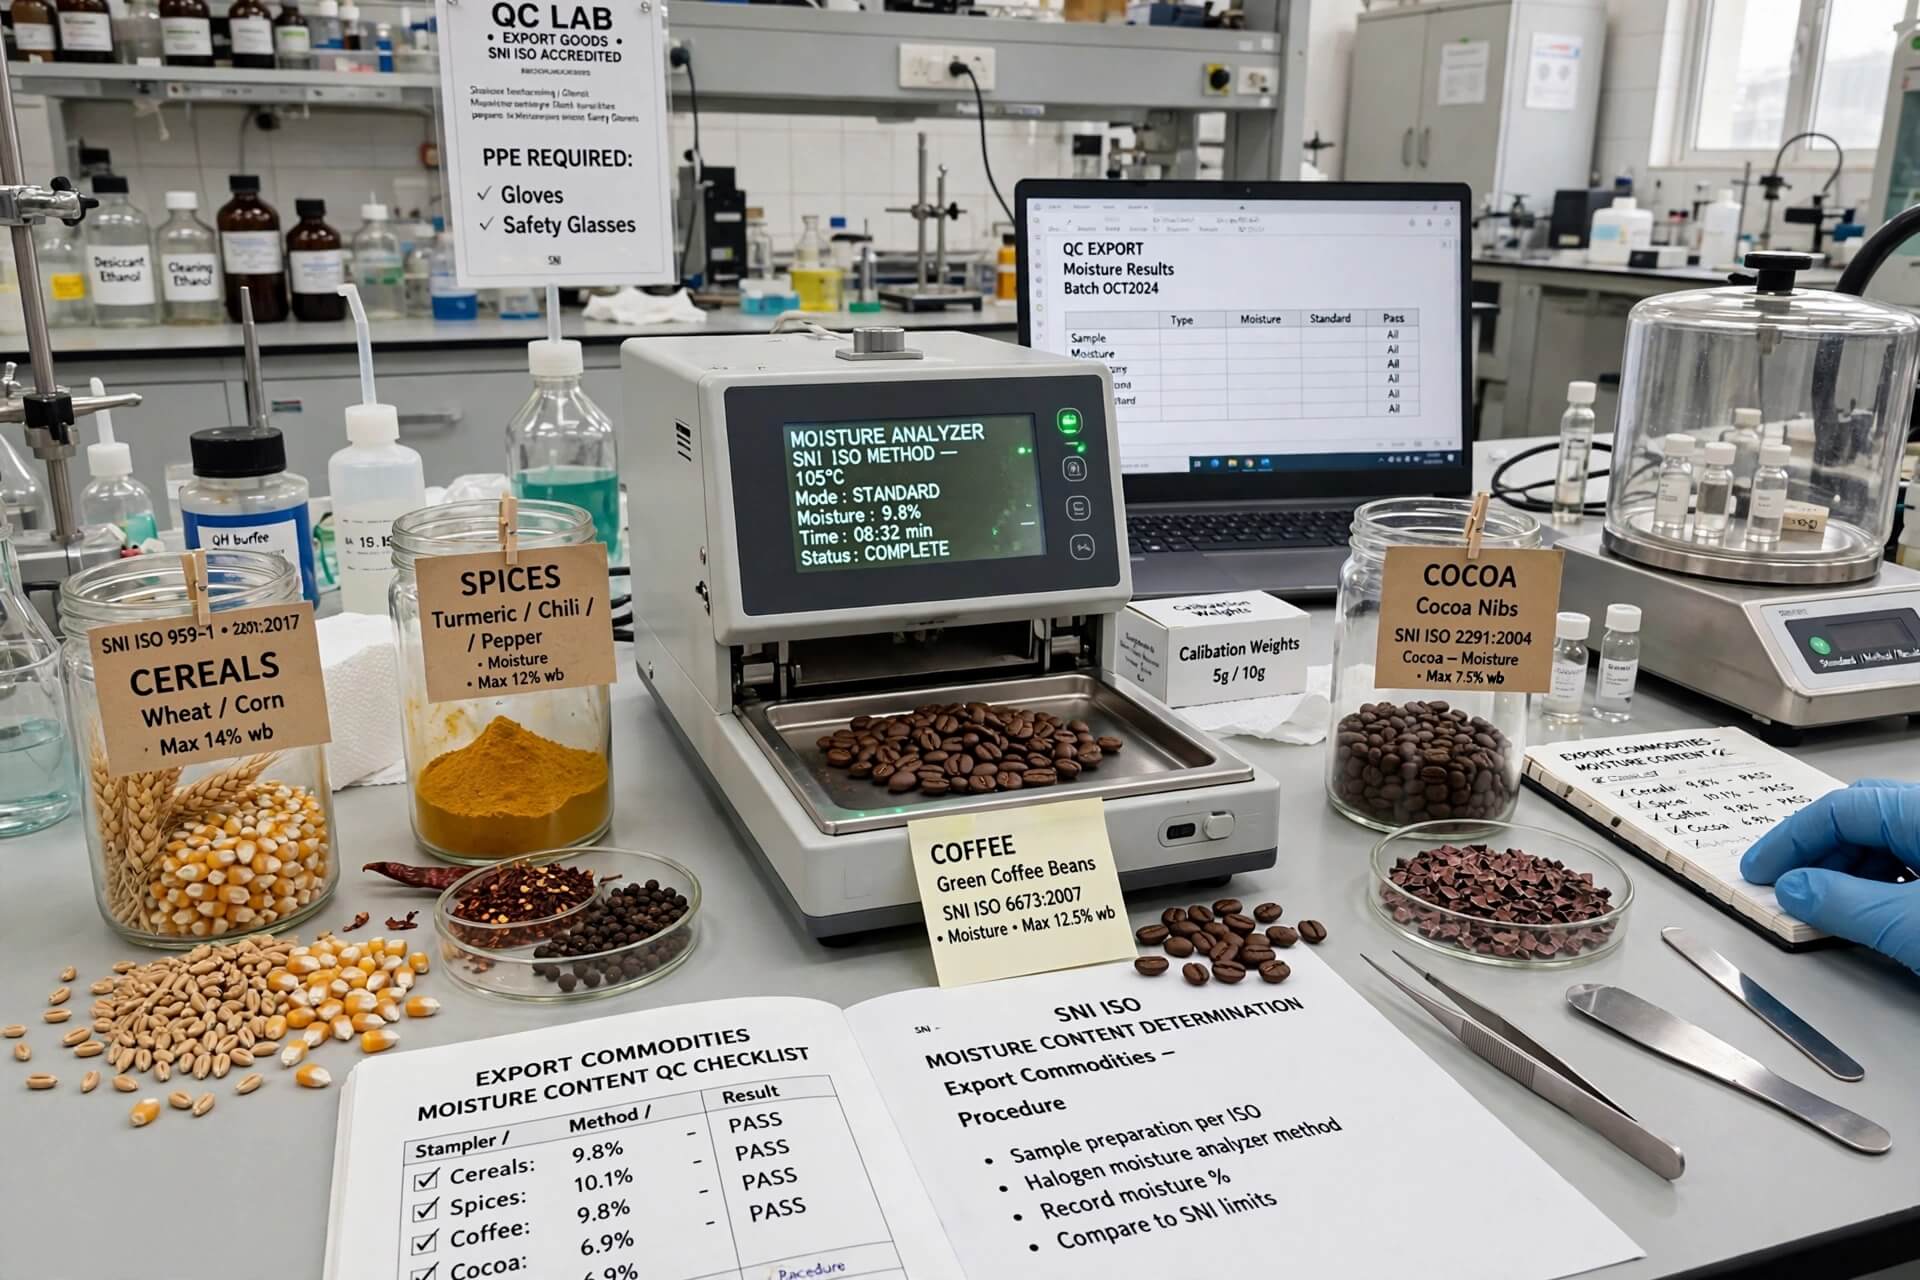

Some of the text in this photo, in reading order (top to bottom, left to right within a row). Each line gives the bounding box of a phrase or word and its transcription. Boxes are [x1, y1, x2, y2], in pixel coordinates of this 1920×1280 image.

[491, 2, 613, 31] QC LAB
[503, 32, 609, 47] EXPORT GOODS
[488, 47, 622, 63] SNI ISO ACCREDITED
[483, 148, 633, 169] PPE REQUIRED:
[501, 184, 564, 204] Gloves
[503, 215, 637, 238] Safety Glasses
[1063, 241, 1144, 257] QC EXPORT
[1063, 261, 1175, 277] Moisture Results
[1064, 281, 1160, 296] Batch OCT2024
[1171, 315, 1194, 327] Type
[1240, 313, 1282, 326] Moisture
[1310, 313, 1352, 325] Standard
[1071, 333, 1106, 345] Sample
[790, 422, 985, 448] MOISTURE ANALYZER
[792, 445, 935, 468] SNI ISO METHOD
[796, 468, 845, 487] 105°C
[852, 483, 940, 503] STANDARD
[881, 505, 922, 521] 9.8%
[853, 524, 900, 543] 08:32
[905, 523, 933, 538] min
[864, 540, 951, 562] COMPLETE
[460, 564, 561, 596] SPICES
[1423, 563, 1517, 589] COCOA
[432, 605, 518, 629] Turmeric
[538, 598, 580, 619] Chili
[1416, 596, 1519, 617] Cocoa Nibs
[101, 635, 130, 655] SNI
[135, 631, 163, 651] ISO
[167, 624, 214, 647] 959-1
[481, 632, 543, 651] Pepper
[1179, 637, 1300, 662] Calibation Weights
[1394, 628, 1532, 646] SNI ISO 2291:2004
[488, 653, 549, 670] Moisture
[1402, 650, 1519, 666] Cocoa Moisture
[130, 651, 280, 697] CEREALS
[478, 667, 565, 689] Max 12% wb
[1213, 665, 1266, 685] 5g 10g
[1426, 670, 1505, 685] Max 7.5% wb
[141, 701, 213, 729] Wheat
[235, 693, 285, 714] Corn
[160, 722, 275, 756] Max 14% wb
[930, 834, 1016, 865] COFFEE
[937, 857, 1096, 893] Green Coffee Beans
[943, 886, 1082, 921] SNI ISO 6673:2007
[948, 905, 1116, 945] Moisture Max 12.5% wb
[1054, 997, 1142, 1023] SNI ISO
[924, 996, 1305, 1069] MOISTURE CONTENT DETERMINATION
[475, 1028, 751, 1087] EXPORT COMMODITIES
[417, 1046, 810, 1122] MOISTURE CONTENT QC CHECKLIST
[944, 1048, 1157, 1097] Export Commodities
[722, 1085, 780, 1105] Result
[568, 1107, 639, 1134] Method
[957, 1097, 1068, 1128] Procedure
[415, 1134, 497, 1159] Stampler
[1010, 1103, 1263, 1165] Sample preparation per ISO
[450, 1112, 783, 1186] Cereals: 9.8% PASS
[1025, 1117, 1343, 1191] Halogen moisture analyzer method
[449, 1139, 790, 1218] Spices: 10.1% PASS
[1040, 1168, 1231, 1220] Record moisture %
[450, 1167, 798, 1249] Coffee: 9.8% PASS
[1056, 1189, 1278, 1250] Compare to SNI limits
[450, 1196, 806, 1280] Cocoa: 6.9% PASS
